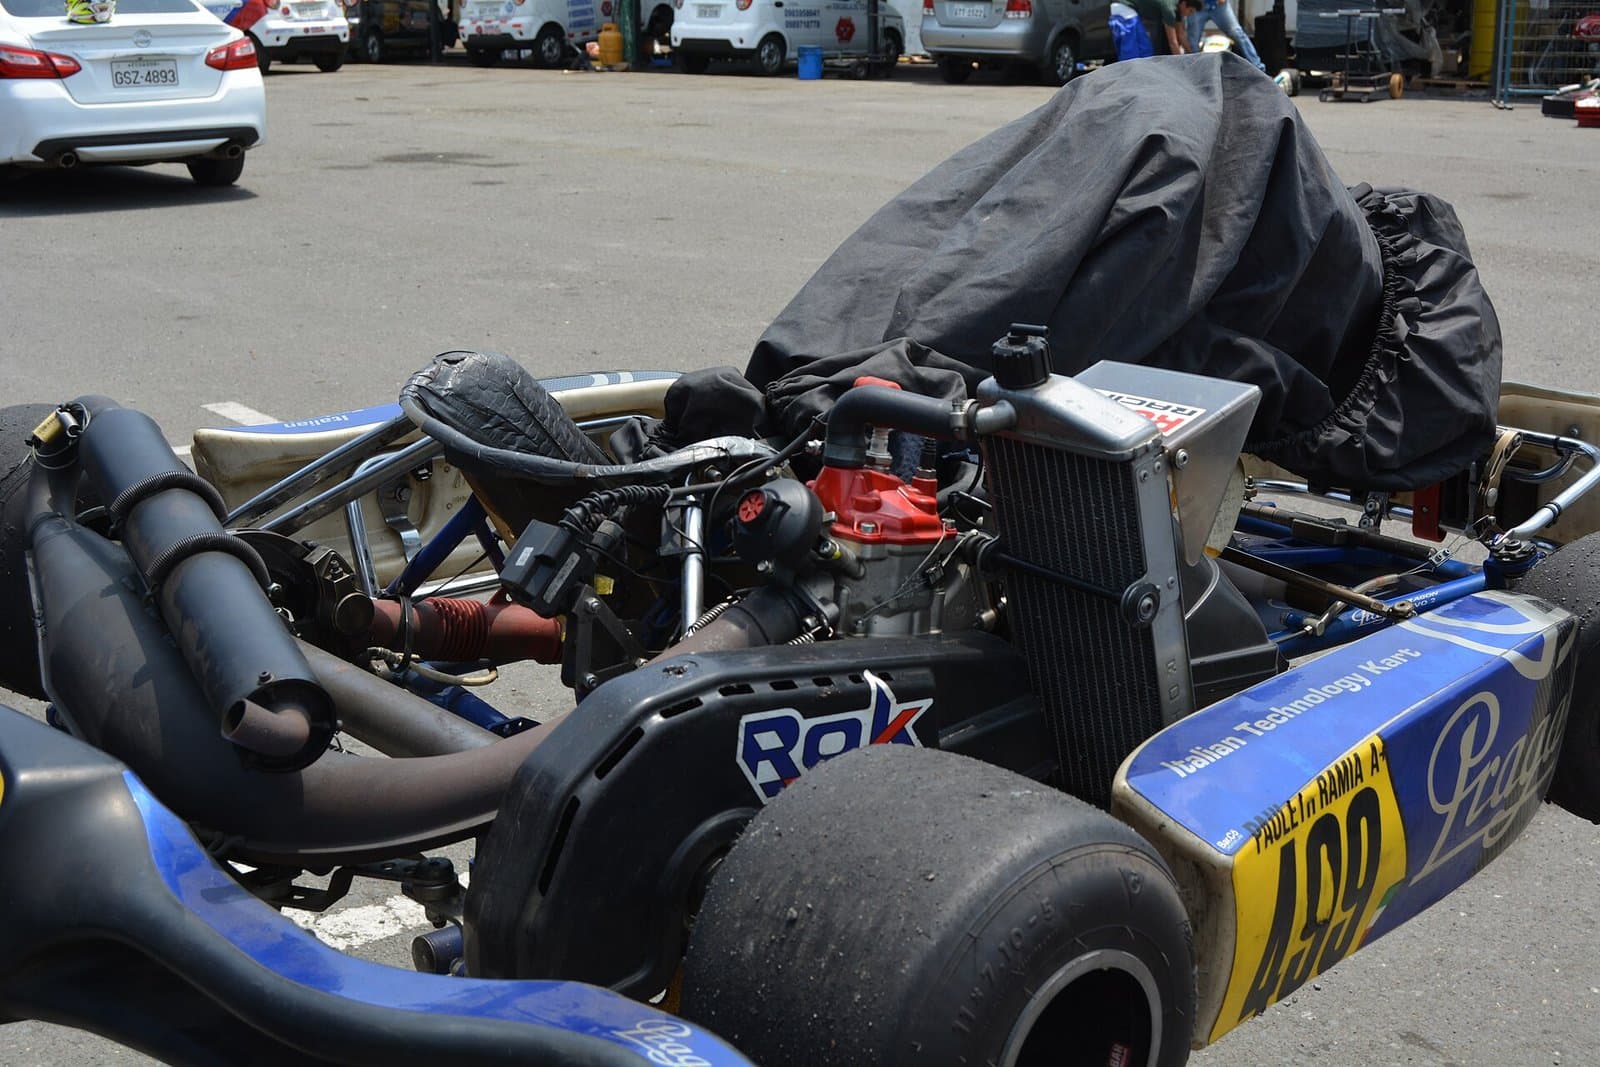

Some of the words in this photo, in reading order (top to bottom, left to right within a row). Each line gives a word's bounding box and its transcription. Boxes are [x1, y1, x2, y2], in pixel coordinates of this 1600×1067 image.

[114, 69, 176, 85] GSZ-4893
[283, 415, 349, 428] Italian
[1160, 736, 1247, 777] Italian
[1234, 664, 1372, 737] Technology
[1359, 648, 1423, 681] Kart
[1317, 751, 1364, 808] RAMIA
[1409, 691, 1570, 888] Praga
[1239, 787, 1382, 1021] 499
[612, 1019, 713, 1067] Prag
